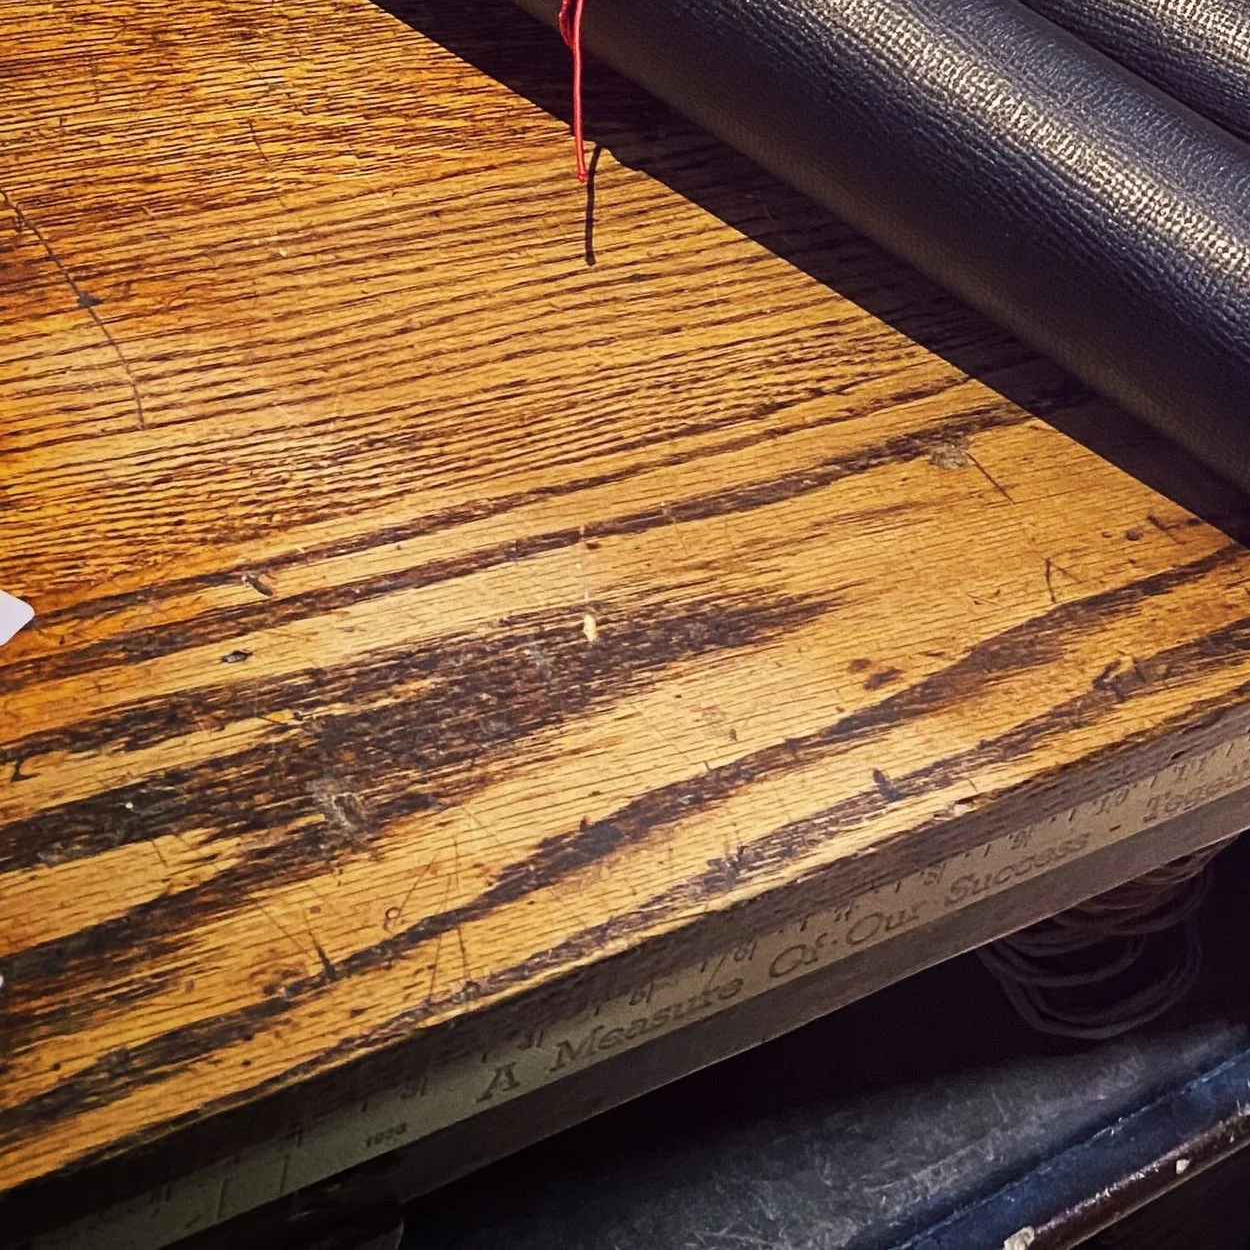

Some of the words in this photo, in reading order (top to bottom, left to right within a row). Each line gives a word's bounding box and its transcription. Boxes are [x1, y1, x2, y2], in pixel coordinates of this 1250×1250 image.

[475, 1061, 521, 1104] A
[545, 978, 744, 1072] Measure
[769, 933, 829, 979] Of
[846, 908, 922, 945] Our
[945, 833, 1091, 907] Success
